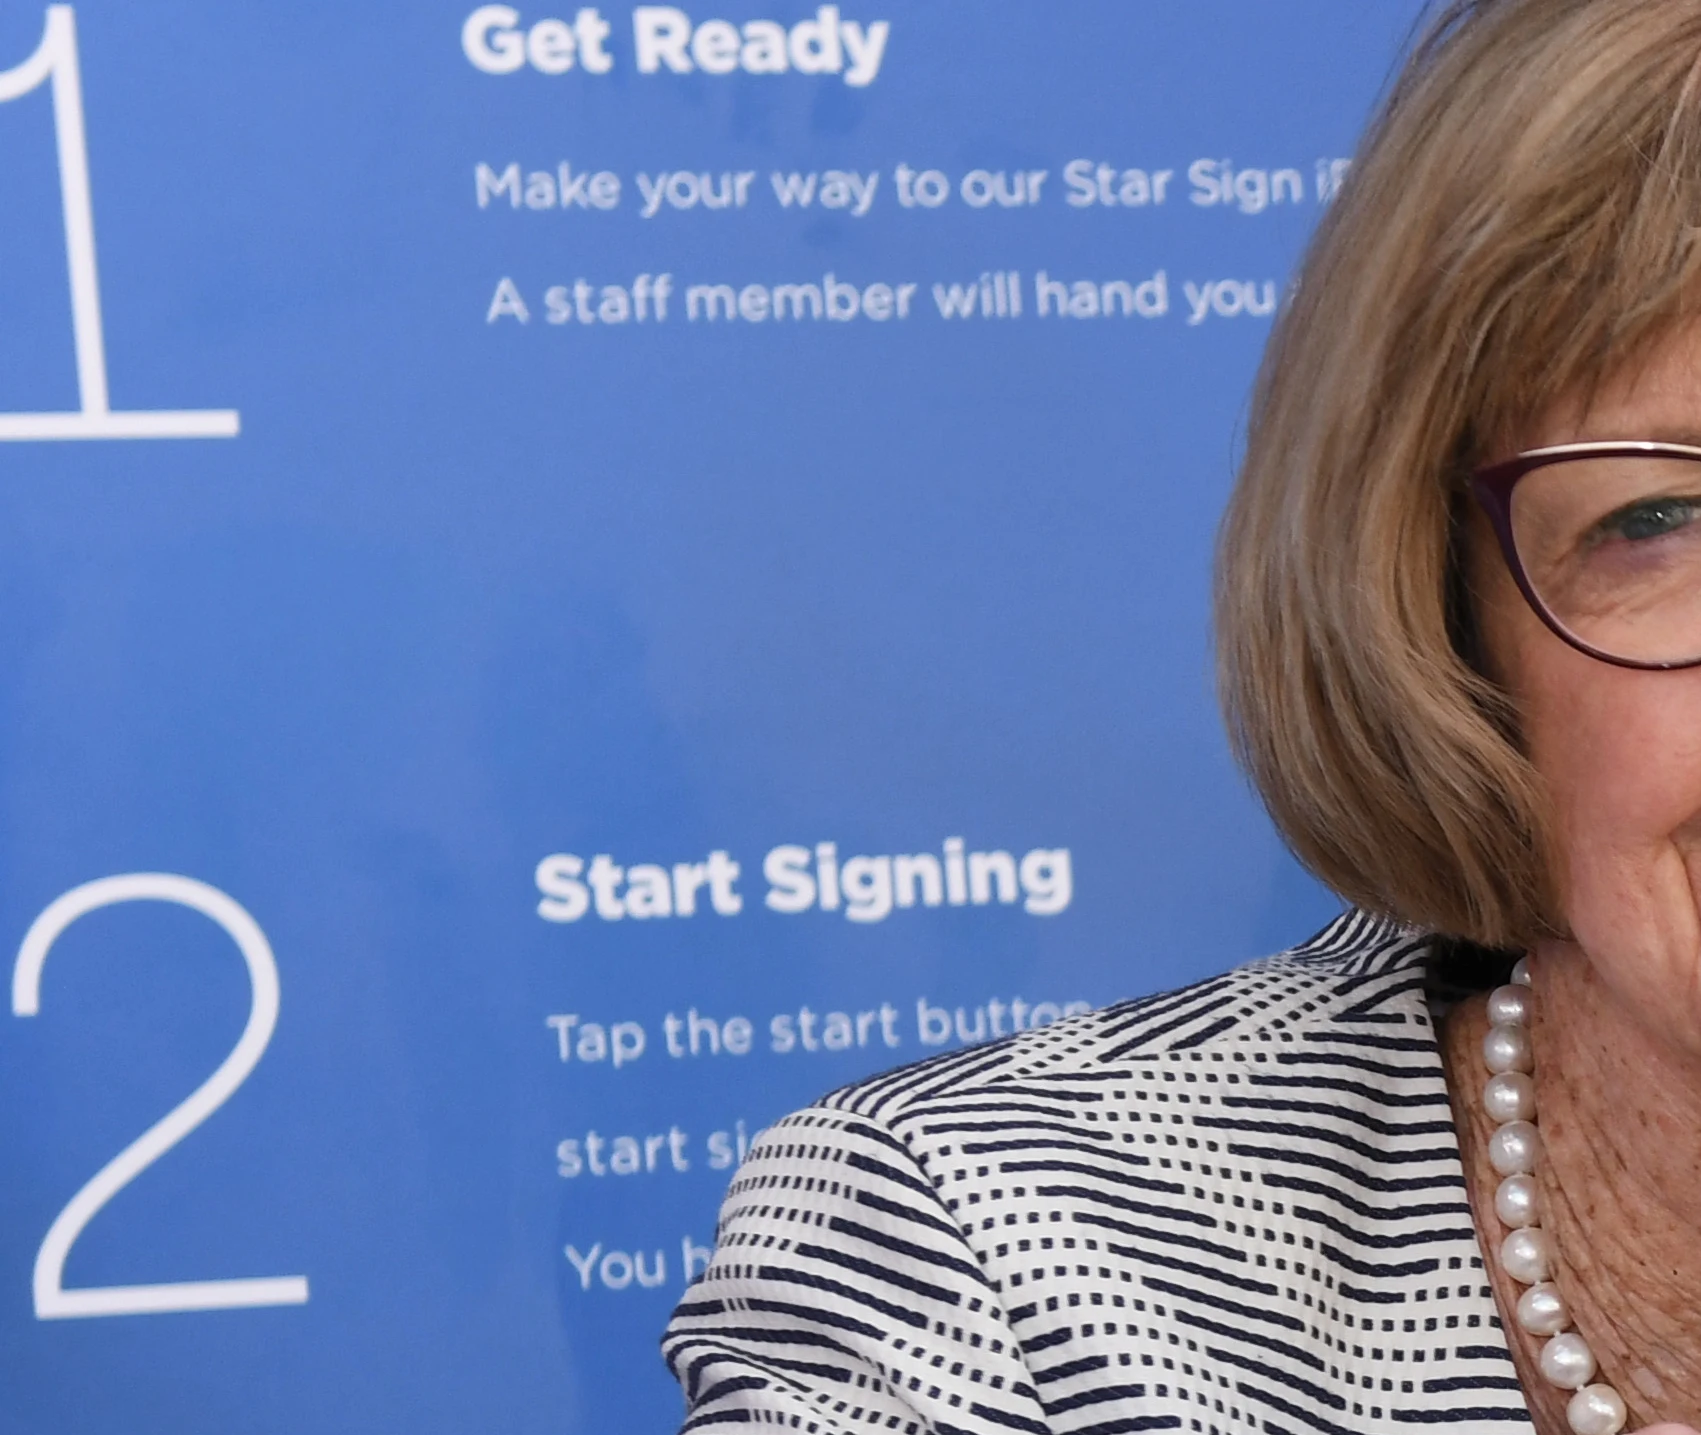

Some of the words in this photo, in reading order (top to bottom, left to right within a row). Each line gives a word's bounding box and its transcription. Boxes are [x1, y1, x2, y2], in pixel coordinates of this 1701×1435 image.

[463, 6, 611, 73] Get
[634, 6, 888, 85] Ready
[476, 161, 620, 208] Make
[637, 172, 754, 218] your
[772, 172, 878, 217] way
[895, 163, 949, 206] to
[961, 170, 1046, 207] our
[1064, 159, 1172, 207] Star
[1189, 159, 1303, 214] Sign
[0, 5, 239, 440] 1
[486, 277, 530, 323] A
[545, 274, 670, 323] staff
[687, 275, 916, 322] member
[934, 272, 1021, 319] will
[1036, 271, 1168, 318] hand
[1184, 279, 1276, 326] you
[536, 851, 741, 922] Start
[765, 838, 1072, 922] Signing
[547, 1014, 645, 1067] Tap
[664, 1009, 752, 1056] the
[771, 1004, 898, 1052] start
[13, 873, 308, 1318] 2
[557, 1128, 688, 1177] start
[565, 1244, 665, 1289] You
